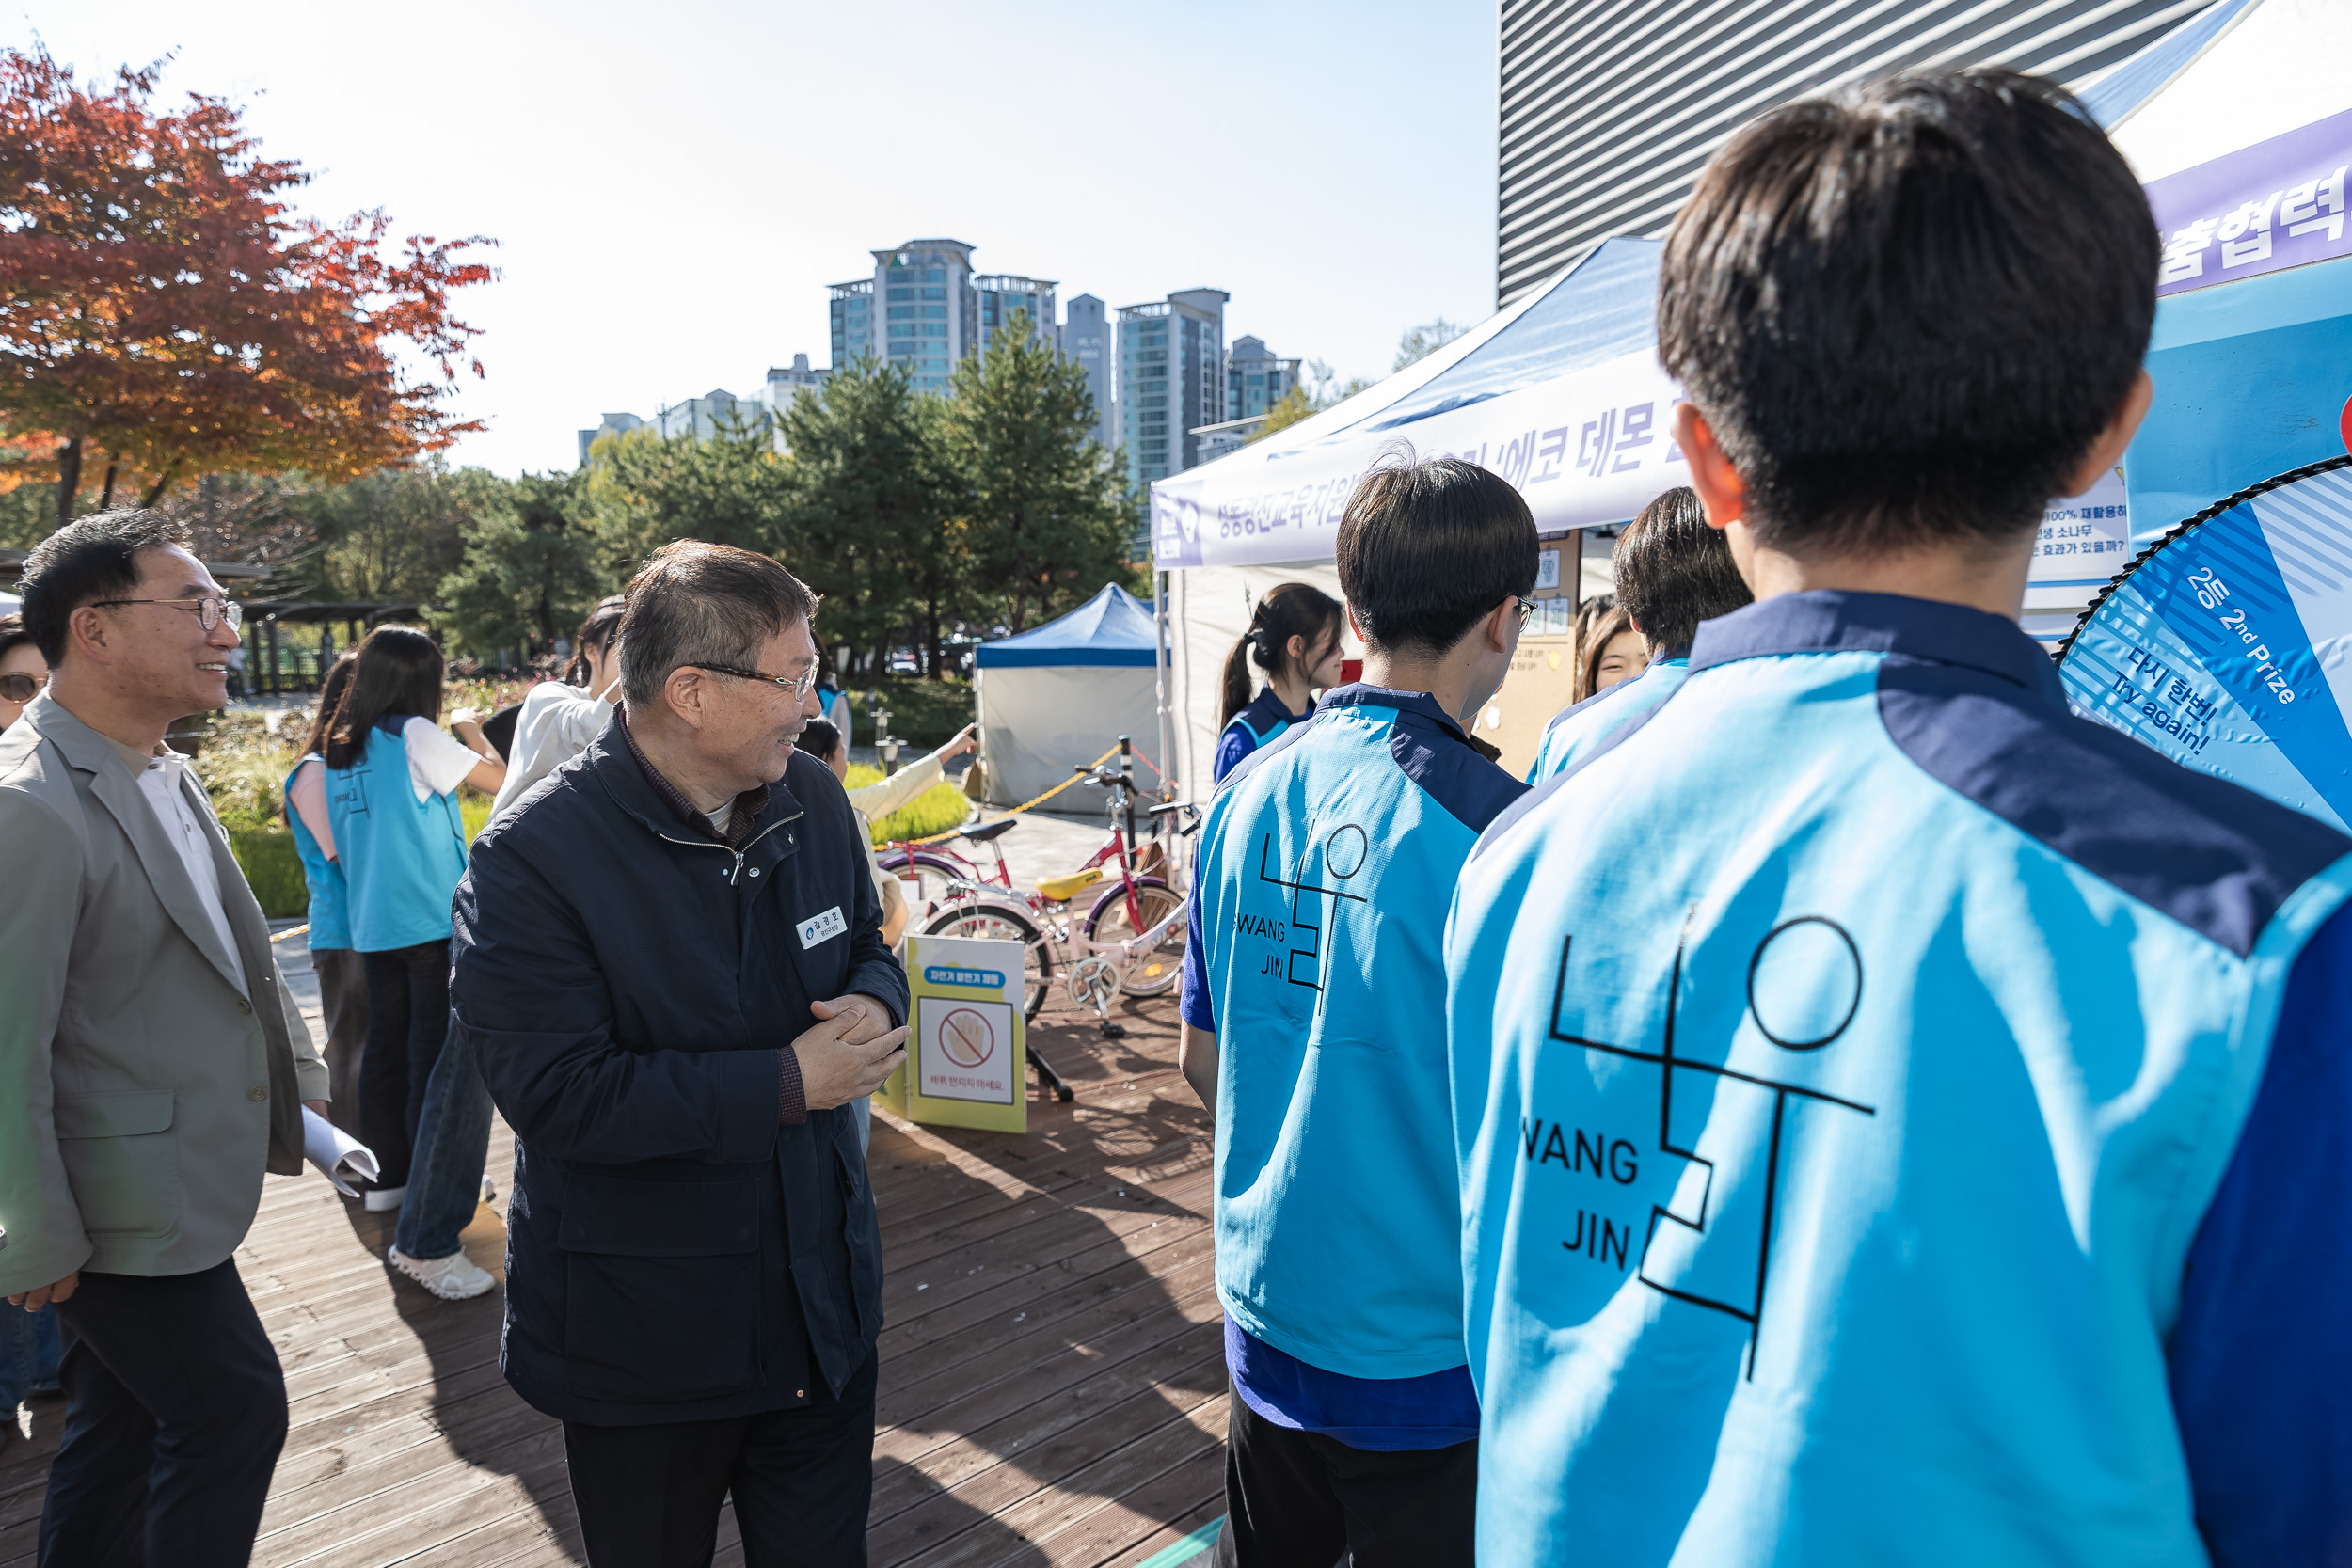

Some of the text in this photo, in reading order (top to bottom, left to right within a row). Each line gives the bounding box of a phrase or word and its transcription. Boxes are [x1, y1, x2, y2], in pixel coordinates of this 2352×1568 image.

[2157, 164, 2352, 287] 춤협력
[1218, 473, 1359, 540] 성동광진교육지원
[1576, 401, 1654, 478] 데몬
[2045, 509, 2078, 522] 100%
[2058, 524, 2093, 538] 소나무
[2043, 543, 2077, 556] 효과가
[2081, 540, 2124, 554] 있을까?
[2187, 566, 2296, 705] 2등 2nd Prize
[2112, 670, 2211, 756] Try again!
[2127, 645, 2218, 728] 다시 한번!
[1233, 912, 1285, 942] WANG
[1261, 954, 1284, 980] JIN
[1562, 1208, 1630, 1272] JIN
